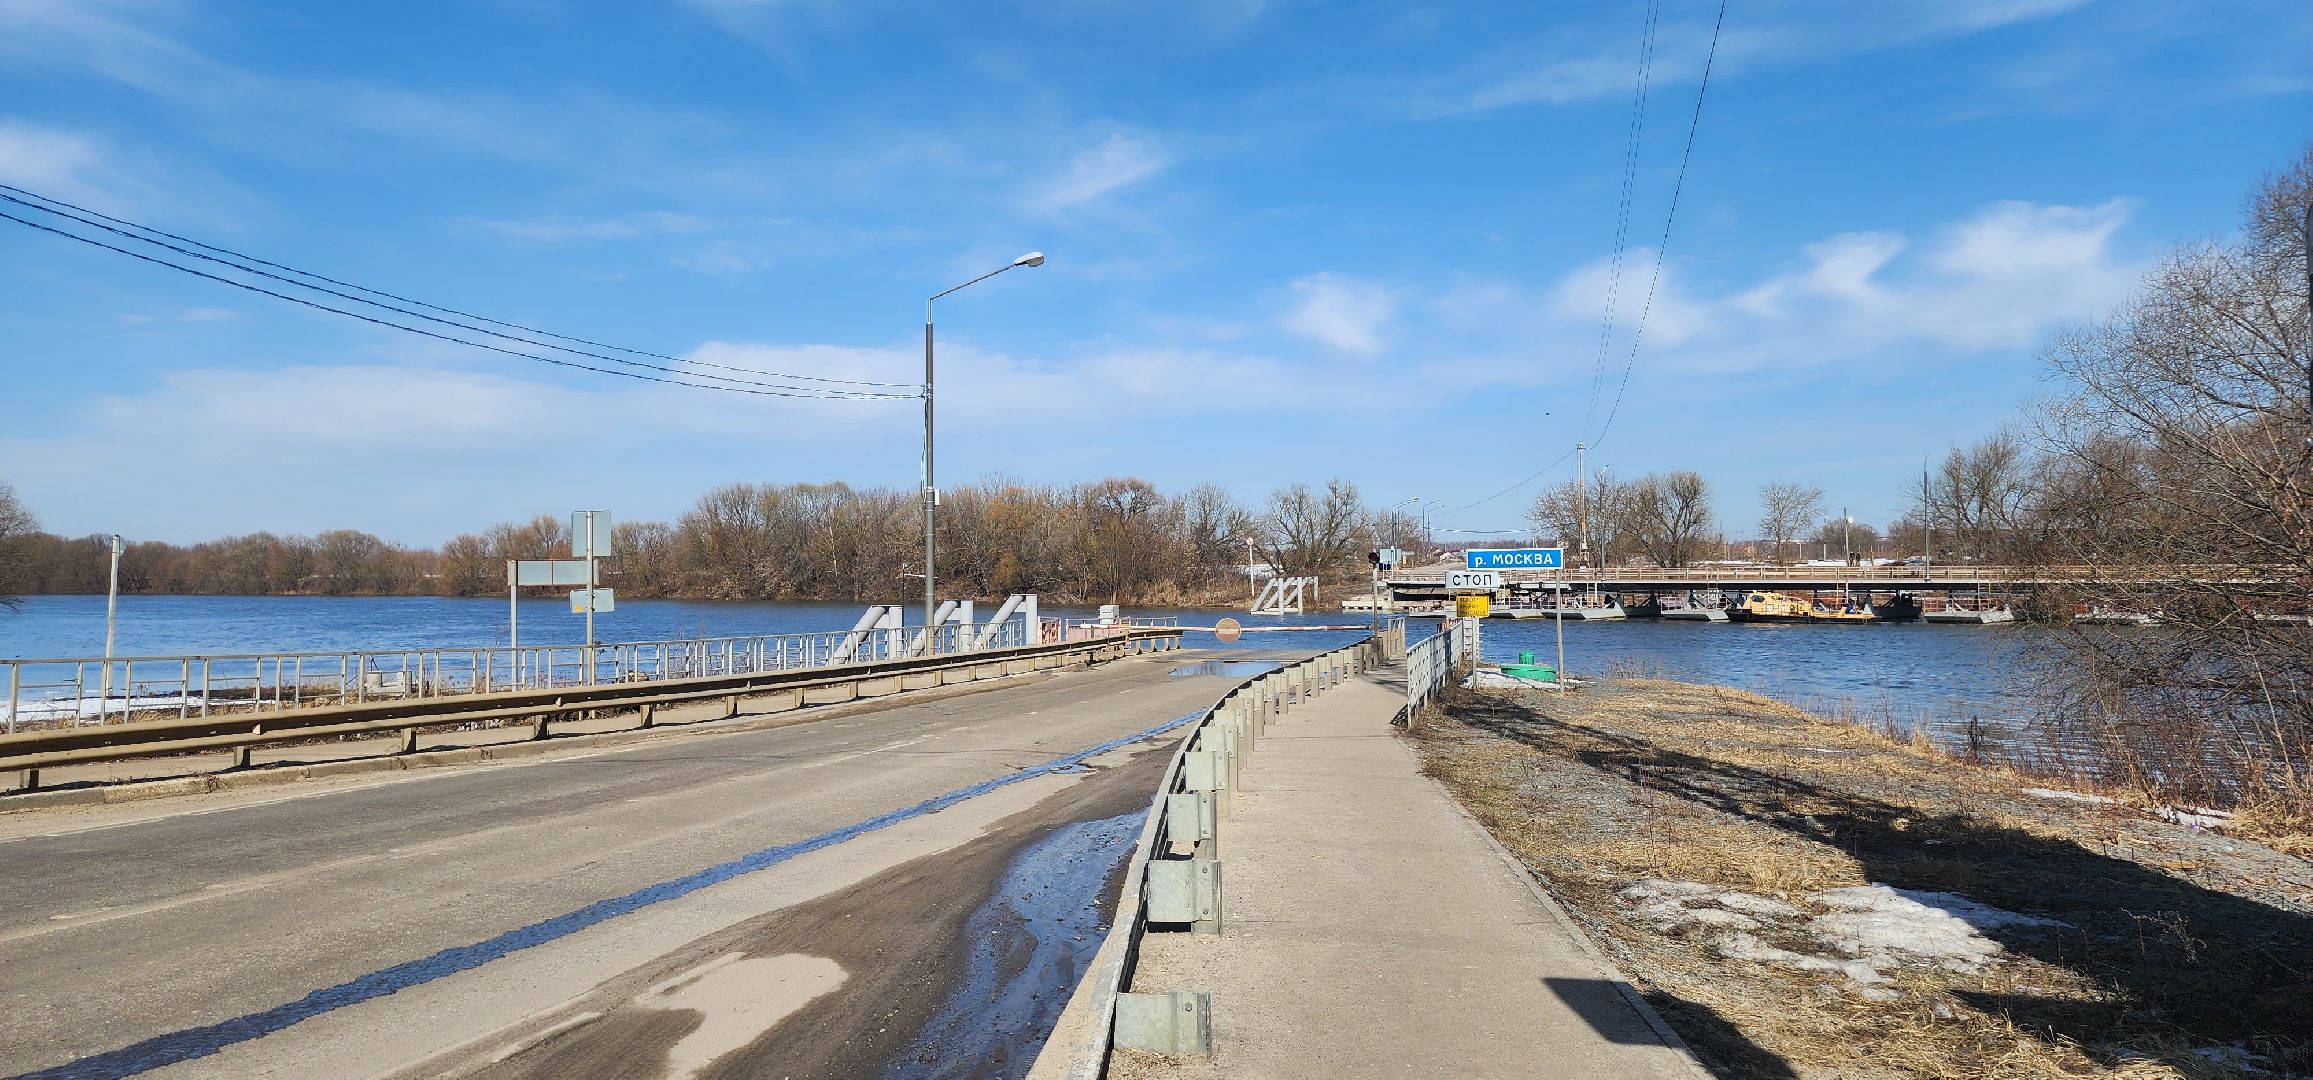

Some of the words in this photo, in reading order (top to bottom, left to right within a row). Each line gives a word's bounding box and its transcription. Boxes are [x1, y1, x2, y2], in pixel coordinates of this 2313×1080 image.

[1475, 556, 1487, 568] р.
[1492, 553, 1553, 565] МОСКВА
[1452, 574, 1492, 586] СТОП
